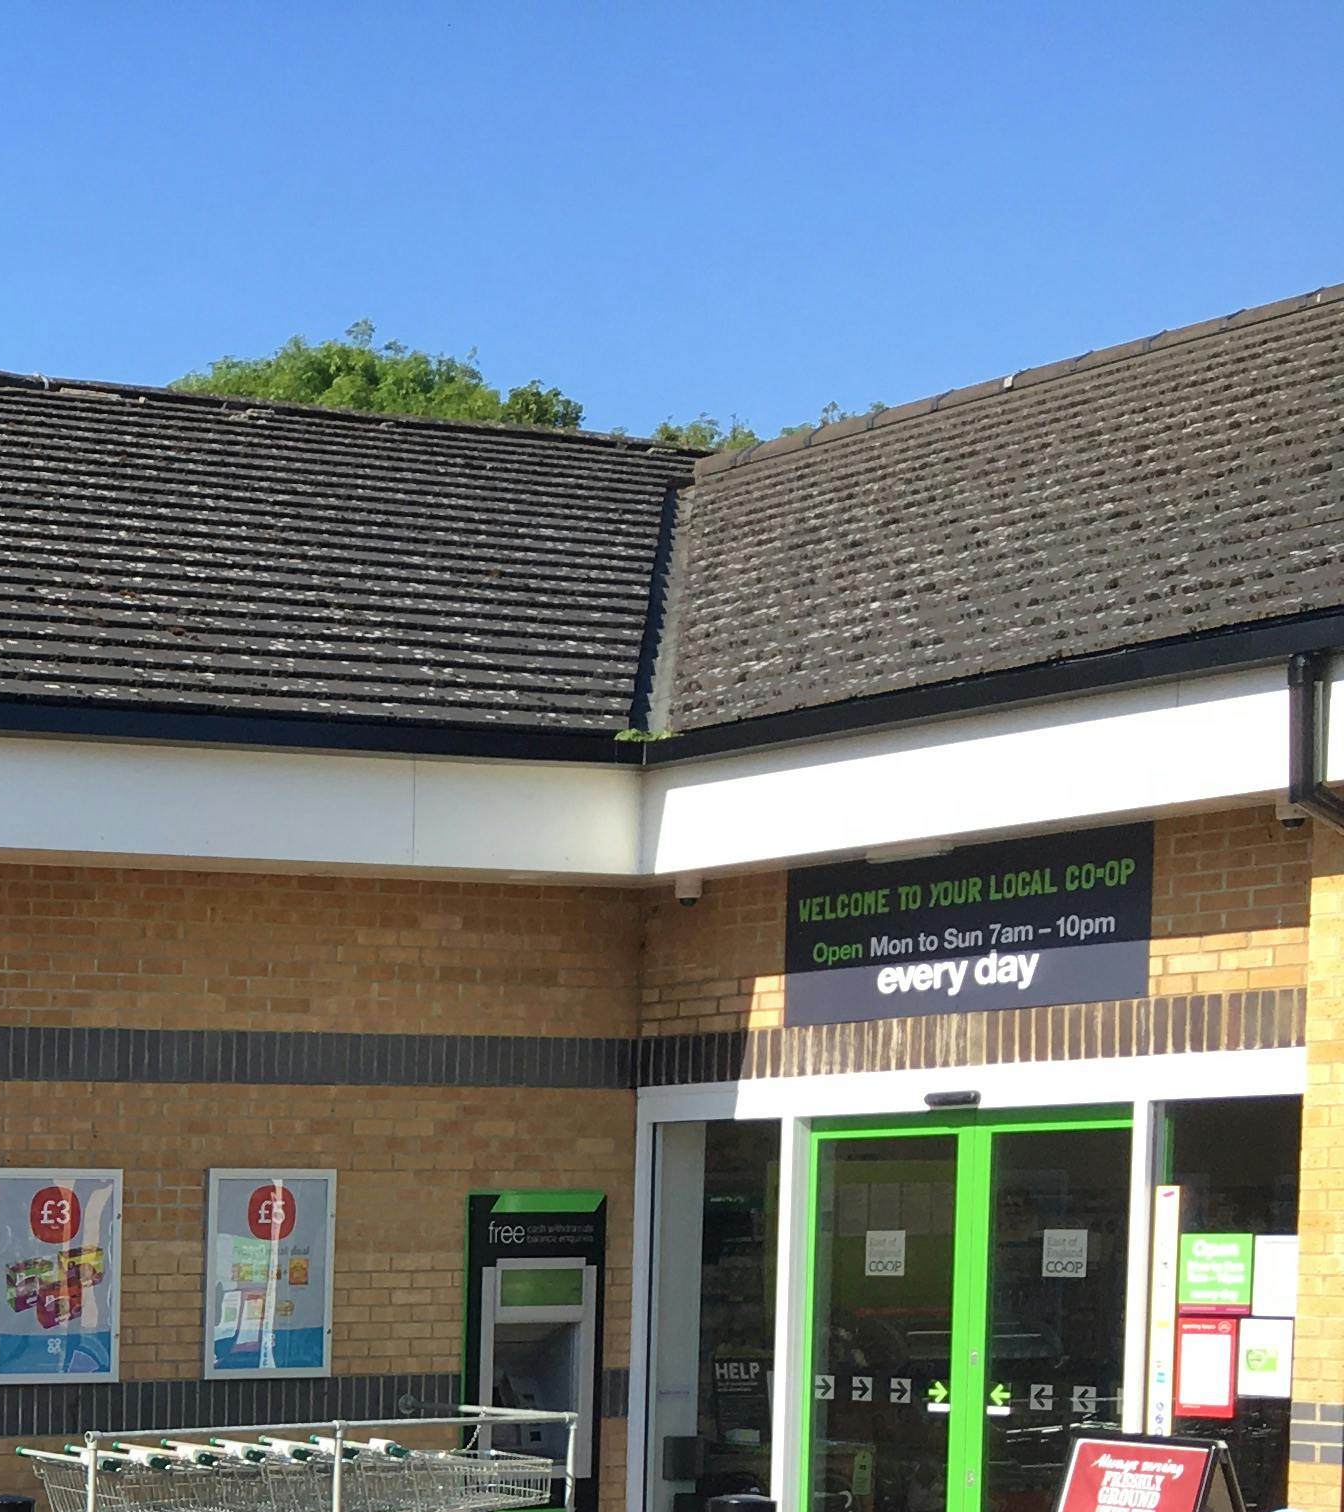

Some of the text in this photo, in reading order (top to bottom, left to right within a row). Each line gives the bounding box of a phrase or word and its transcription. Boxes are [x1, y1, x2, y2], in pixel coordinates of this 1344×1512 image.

[799, 857, 1136, 923] WELCOME TO YOUR LOCAL CO-OP
[813, 941, 863, 966] Open
[869, 935, 913, 958] Mon
[917, 932, 939, 952] to
[943, 927, 983, 949] Sun
[989, 922, 1033, 945] 7am
[1056, 914, 1116, 942] 10pm
[876, 949, 1041, 997] every day
[40, 1199, 71, 1225] £3
[258, 1199, 286, 1224] £5
[488, 1220, 526, 1244] free
[715, 1362, 760, 1379] HELP
[1091, 1453, 1138, 1474] Always
[1100, 1470, 1166, 1492] FRESHLY
[1097, 1488, 1162, 1508] GROUND
